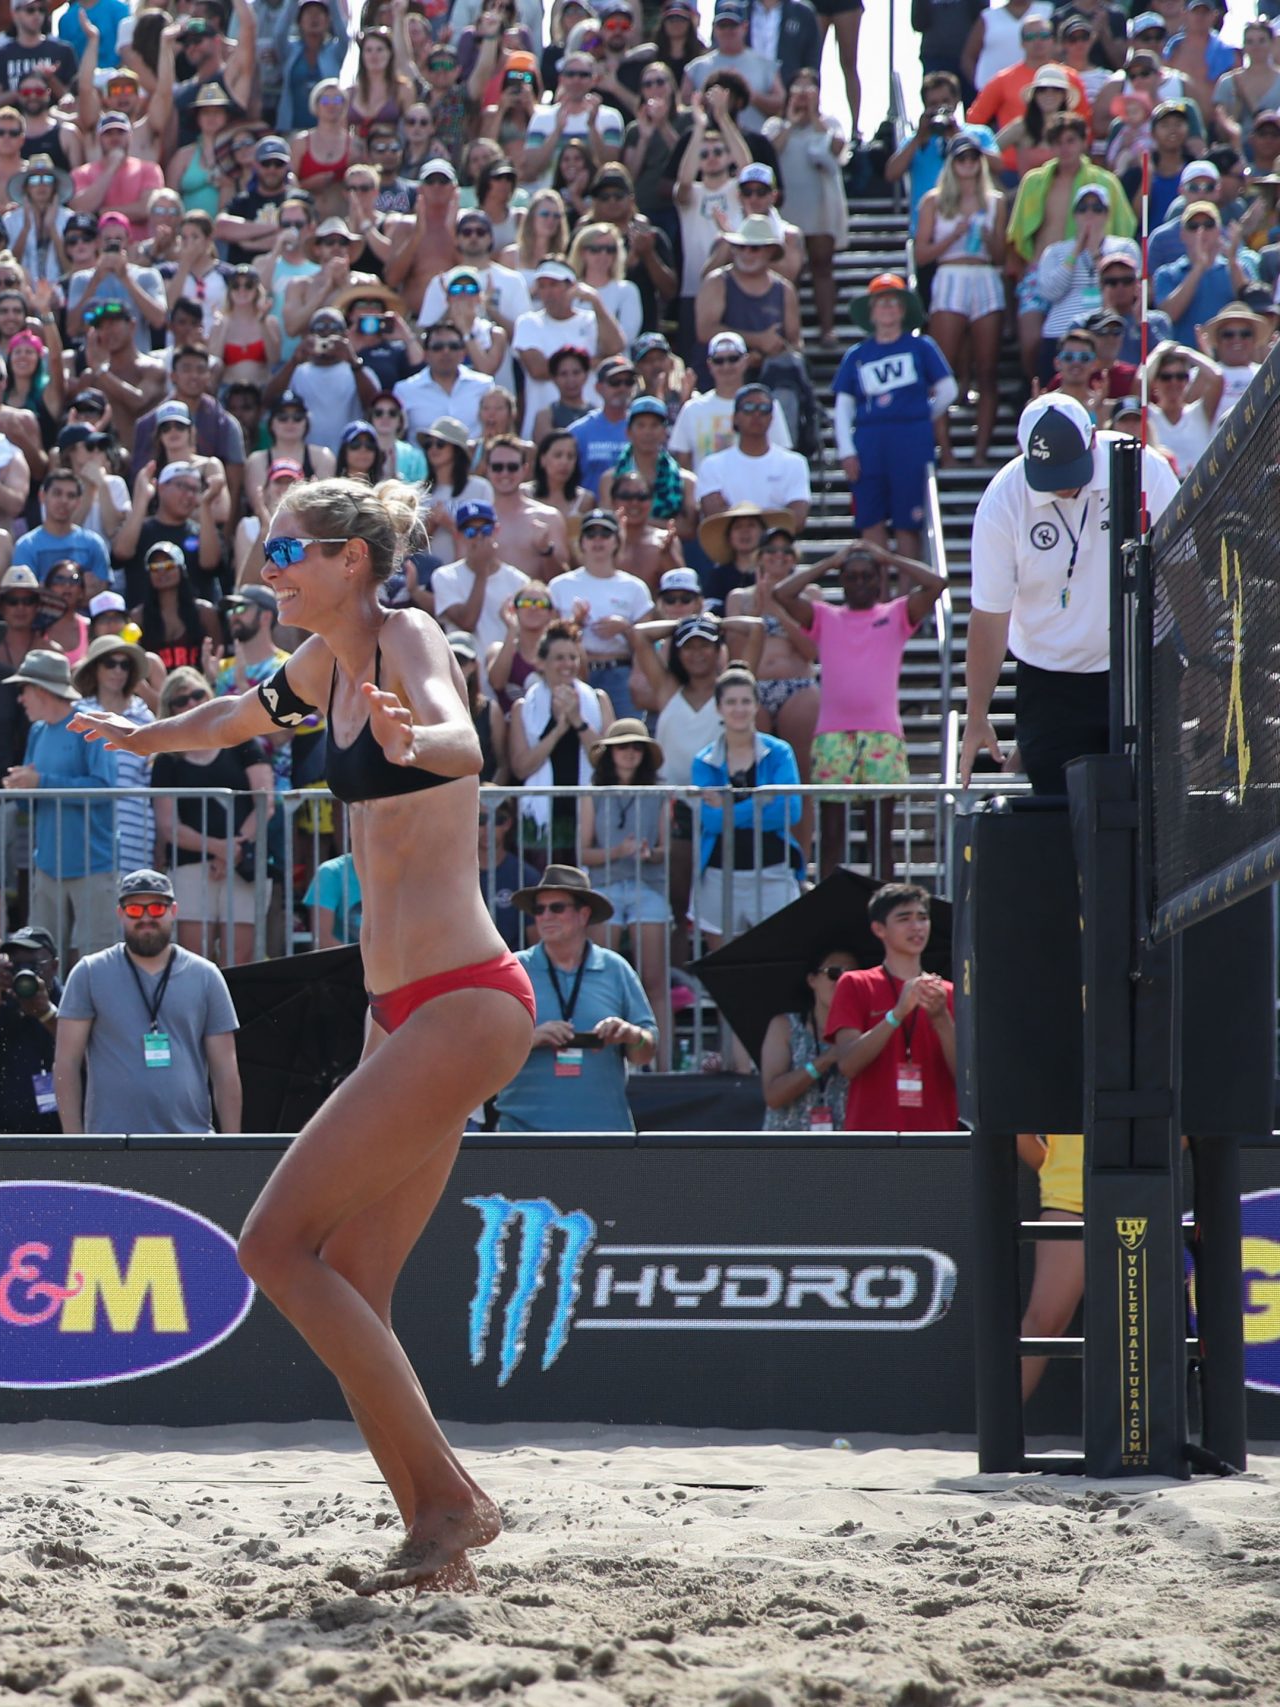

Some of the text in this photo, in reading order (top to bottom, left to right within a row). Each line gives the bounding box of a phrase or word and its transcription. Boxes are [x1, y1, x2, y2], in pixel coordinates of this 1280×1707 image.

[874, 360, 903, 384] W
[1031, 448, 1051, 460] avp
[592, 1264, 919, 1308] HYDRO
